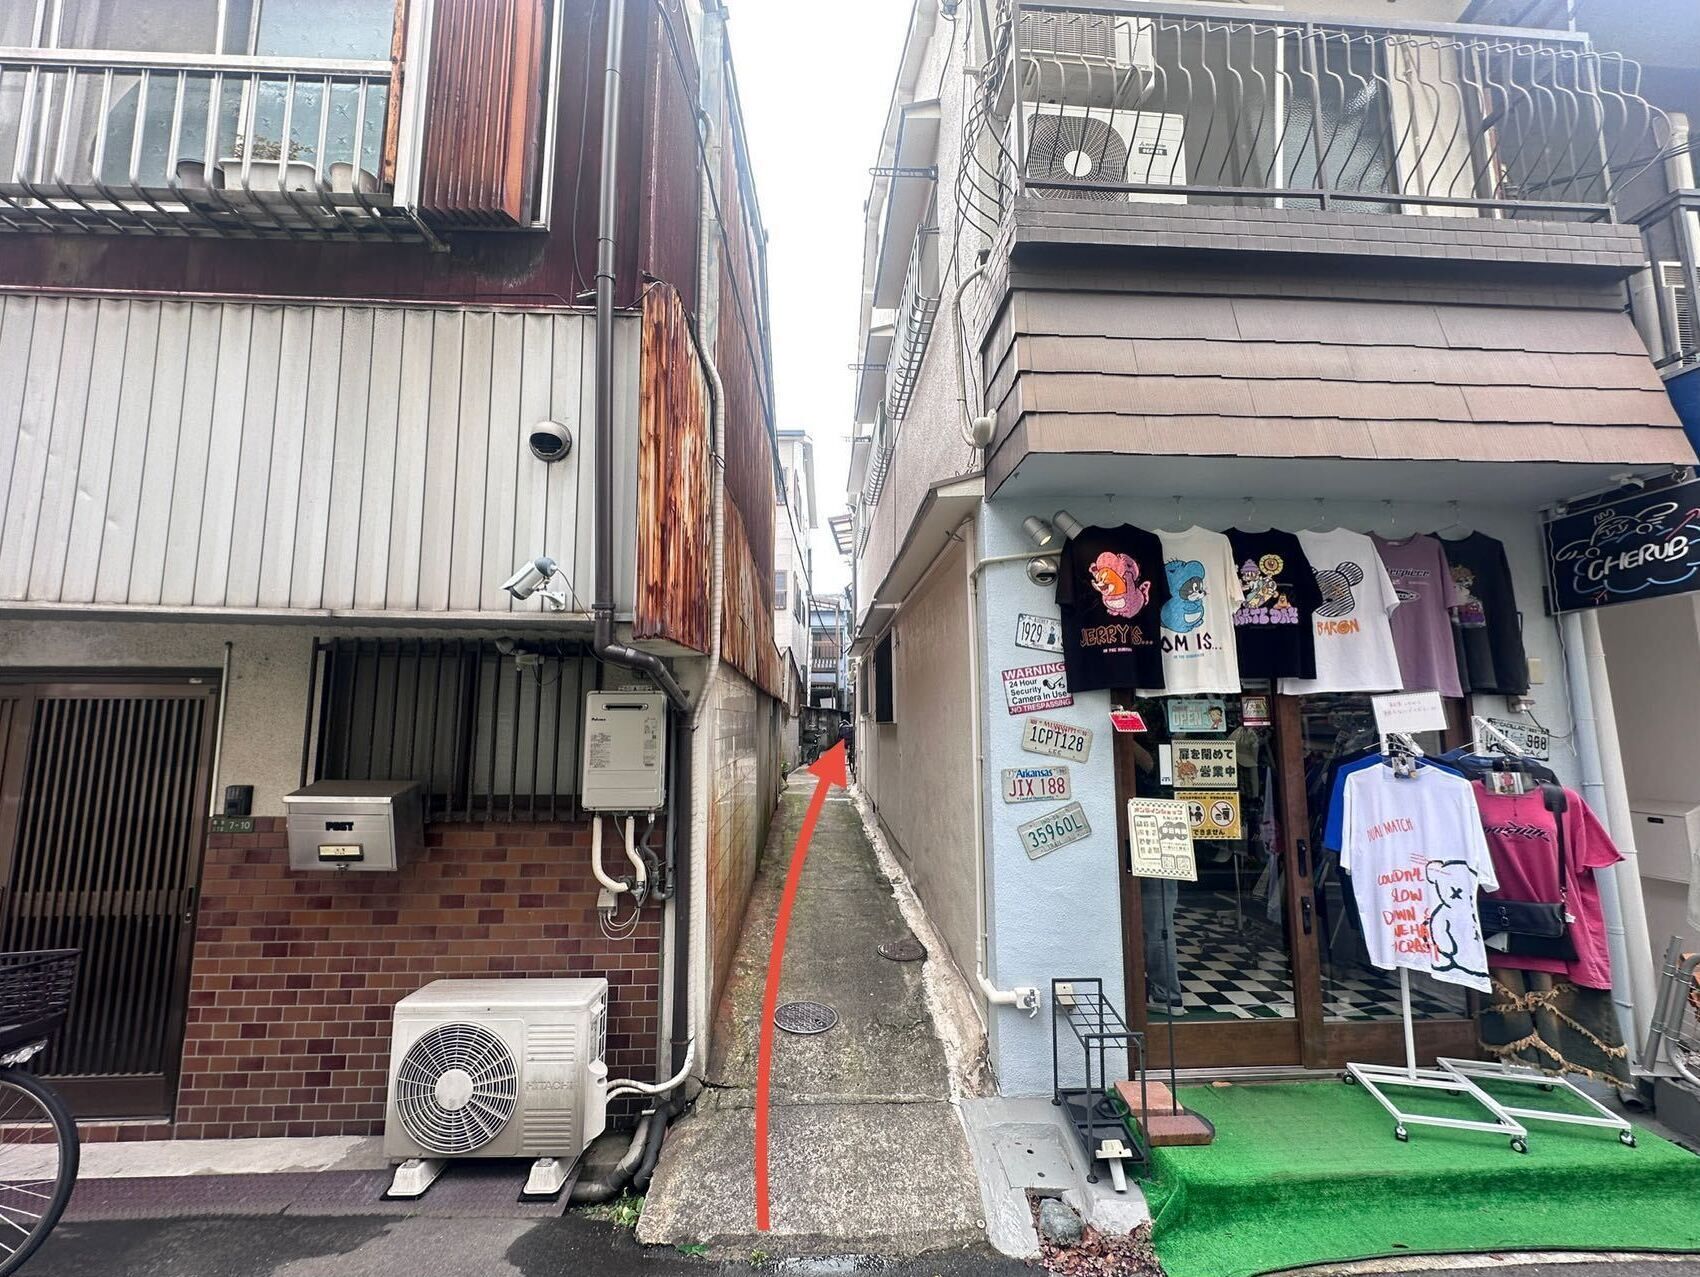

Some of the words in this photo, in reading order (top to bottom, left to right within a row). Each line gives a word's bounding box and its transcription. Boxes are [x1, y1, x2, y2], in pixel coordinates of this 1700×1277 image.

[1588, 536, 1689, 580] CHERUB
[1021, 621, 1043, 642] 1929
[1317, 619, 1359, 636] BARON
[1004, 662, 1065, 680] WARNING
[1009, 680, 1018, 688] 24
[1020, 678, 1037, 686] Hour
[1011, 687, 1042, 696] Security
[1012, 694, 1042, 704] Camera
[1052, 689, 1067, 699] Use
[1010, 705, 1021, 714] NO
[1021, 699, 1072, 712] TRESPASSING
[1030, 726, 1084, 752] 1CPT128
[1178, 748, 1234, 760] 扉を閉めて
[1016, 769, 1053, 778] Arkansas
[1200, 765, 1236, 778] 営業中
[1009, 778, 1034, 797] JIX
[1041, 777, 1066, 796] 188
[229, 821, 250, 830] 7-10
[526, 1080, 576, 1090] HITACHI
